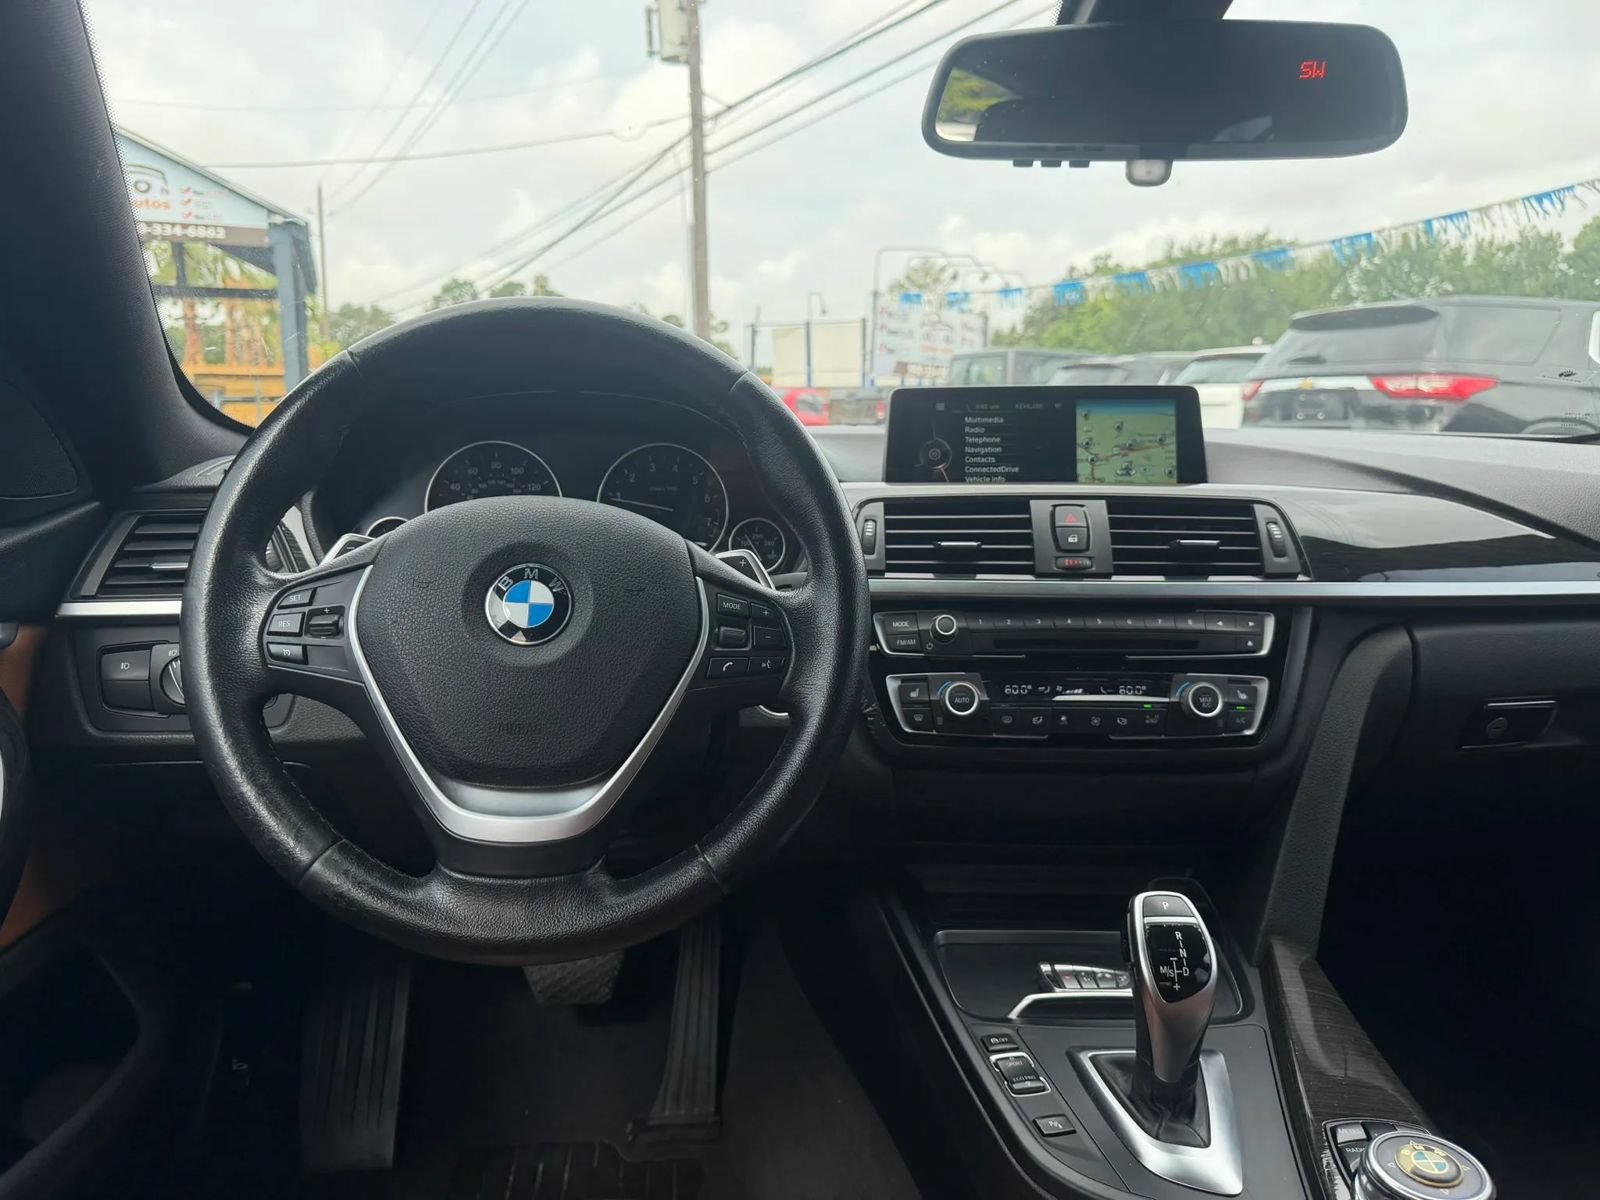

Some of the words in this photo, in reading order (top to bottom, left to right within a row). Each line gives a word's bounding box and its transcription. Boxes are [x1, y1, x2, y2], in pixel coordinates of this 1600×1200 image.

[1299, 61, 1326, 78] SW
[965, 416, 1004, 424] Multimedia
[965, 426, 985, 434] Radio
[965, 436, 1001, 444] Telephone
[965, 446, 1002, 455] Navigation
[965, 456, 995, 464] Contacts
[965, 466, 1019, 474] ConnectedDrive
[497, 567, 565, 593] BMW
[289, 594, 302, 602] SET
[722, 602, 742, 611] MODE
[892, 620, 910, 628] MODE
[954, 696, 970, 704] AUTO
[1162, 901, 1169, 910] P
[1175, 931, 1183, 940] R
[1179, 948, 1188, 958] N
[1182, 966, 1190, 977] D
